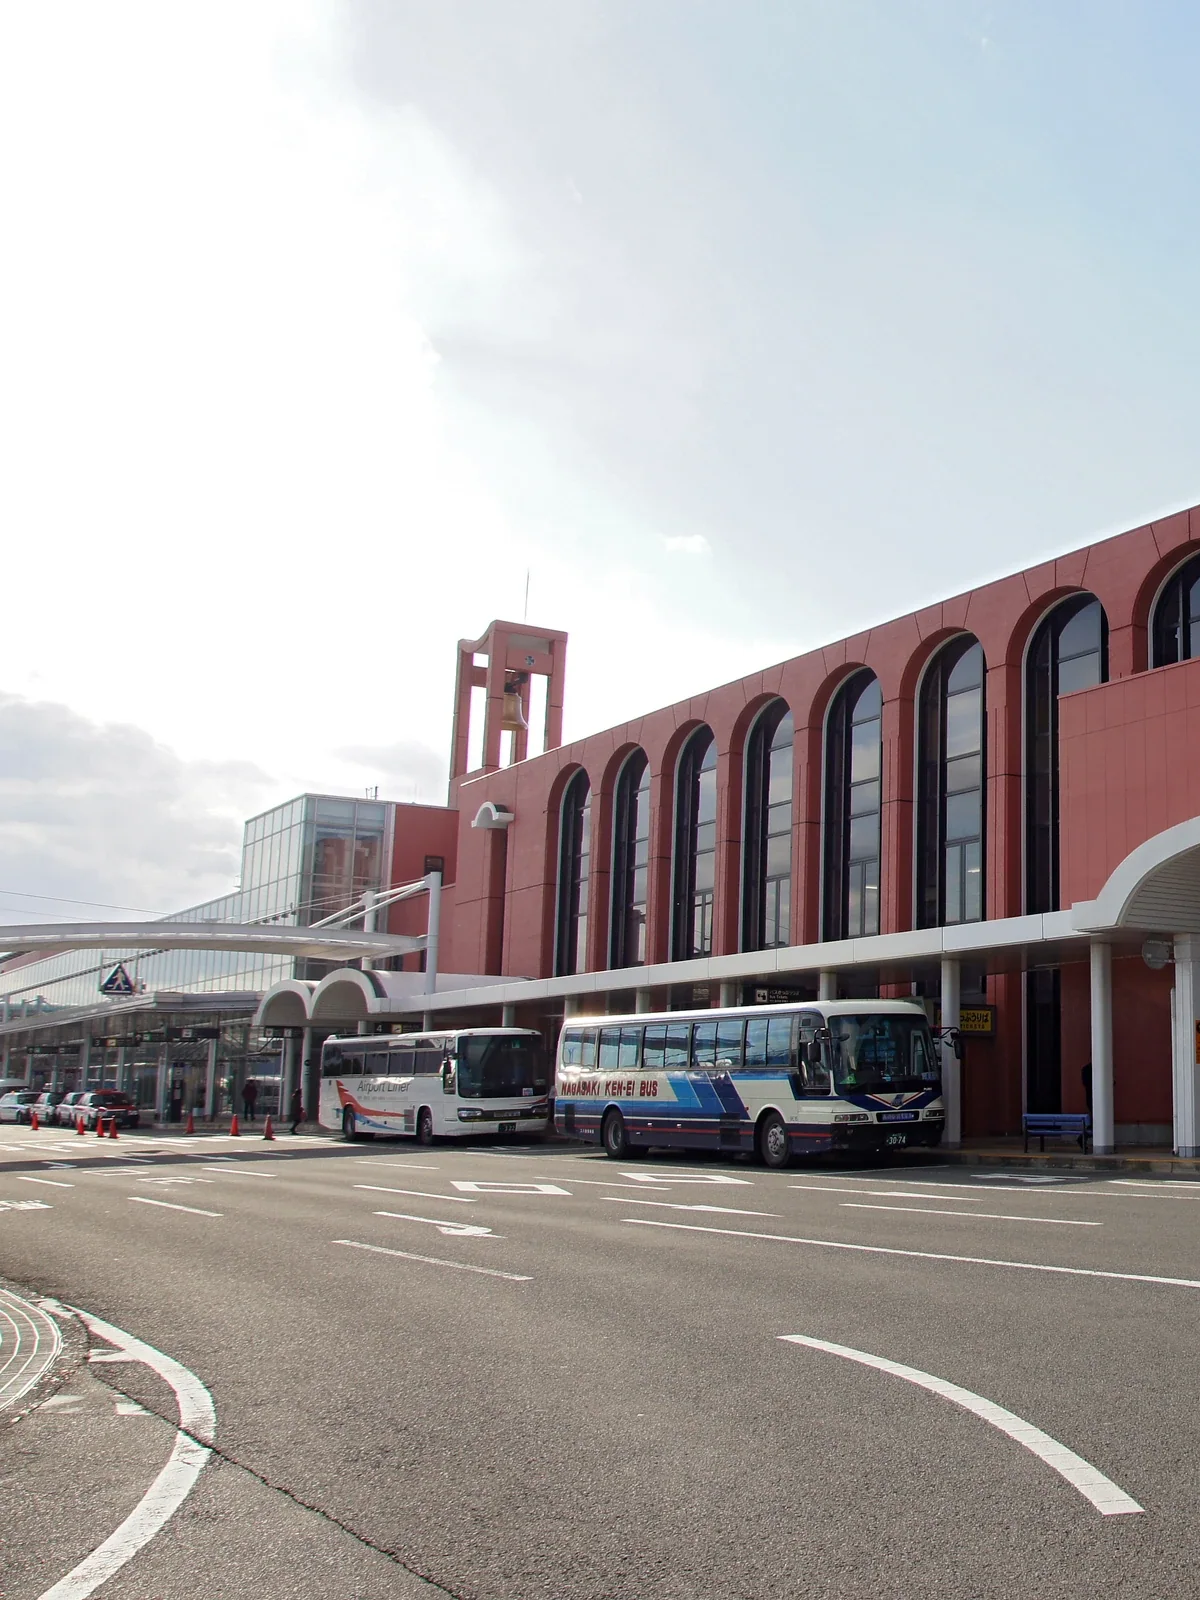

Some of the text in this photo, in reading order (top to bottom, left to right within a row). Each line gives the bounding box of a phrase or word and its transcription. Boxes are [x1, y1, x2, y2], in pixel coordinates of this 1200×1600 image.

[960, 1012, 989, 1022] っぷうりば
[376, 1024, 383, 1032] 4
[357, 1080, 411, 1094] Airport Liner
[561, 1081, 600, 1096] NAGASAKI
[640, 1080, 658, 1097] BUS
